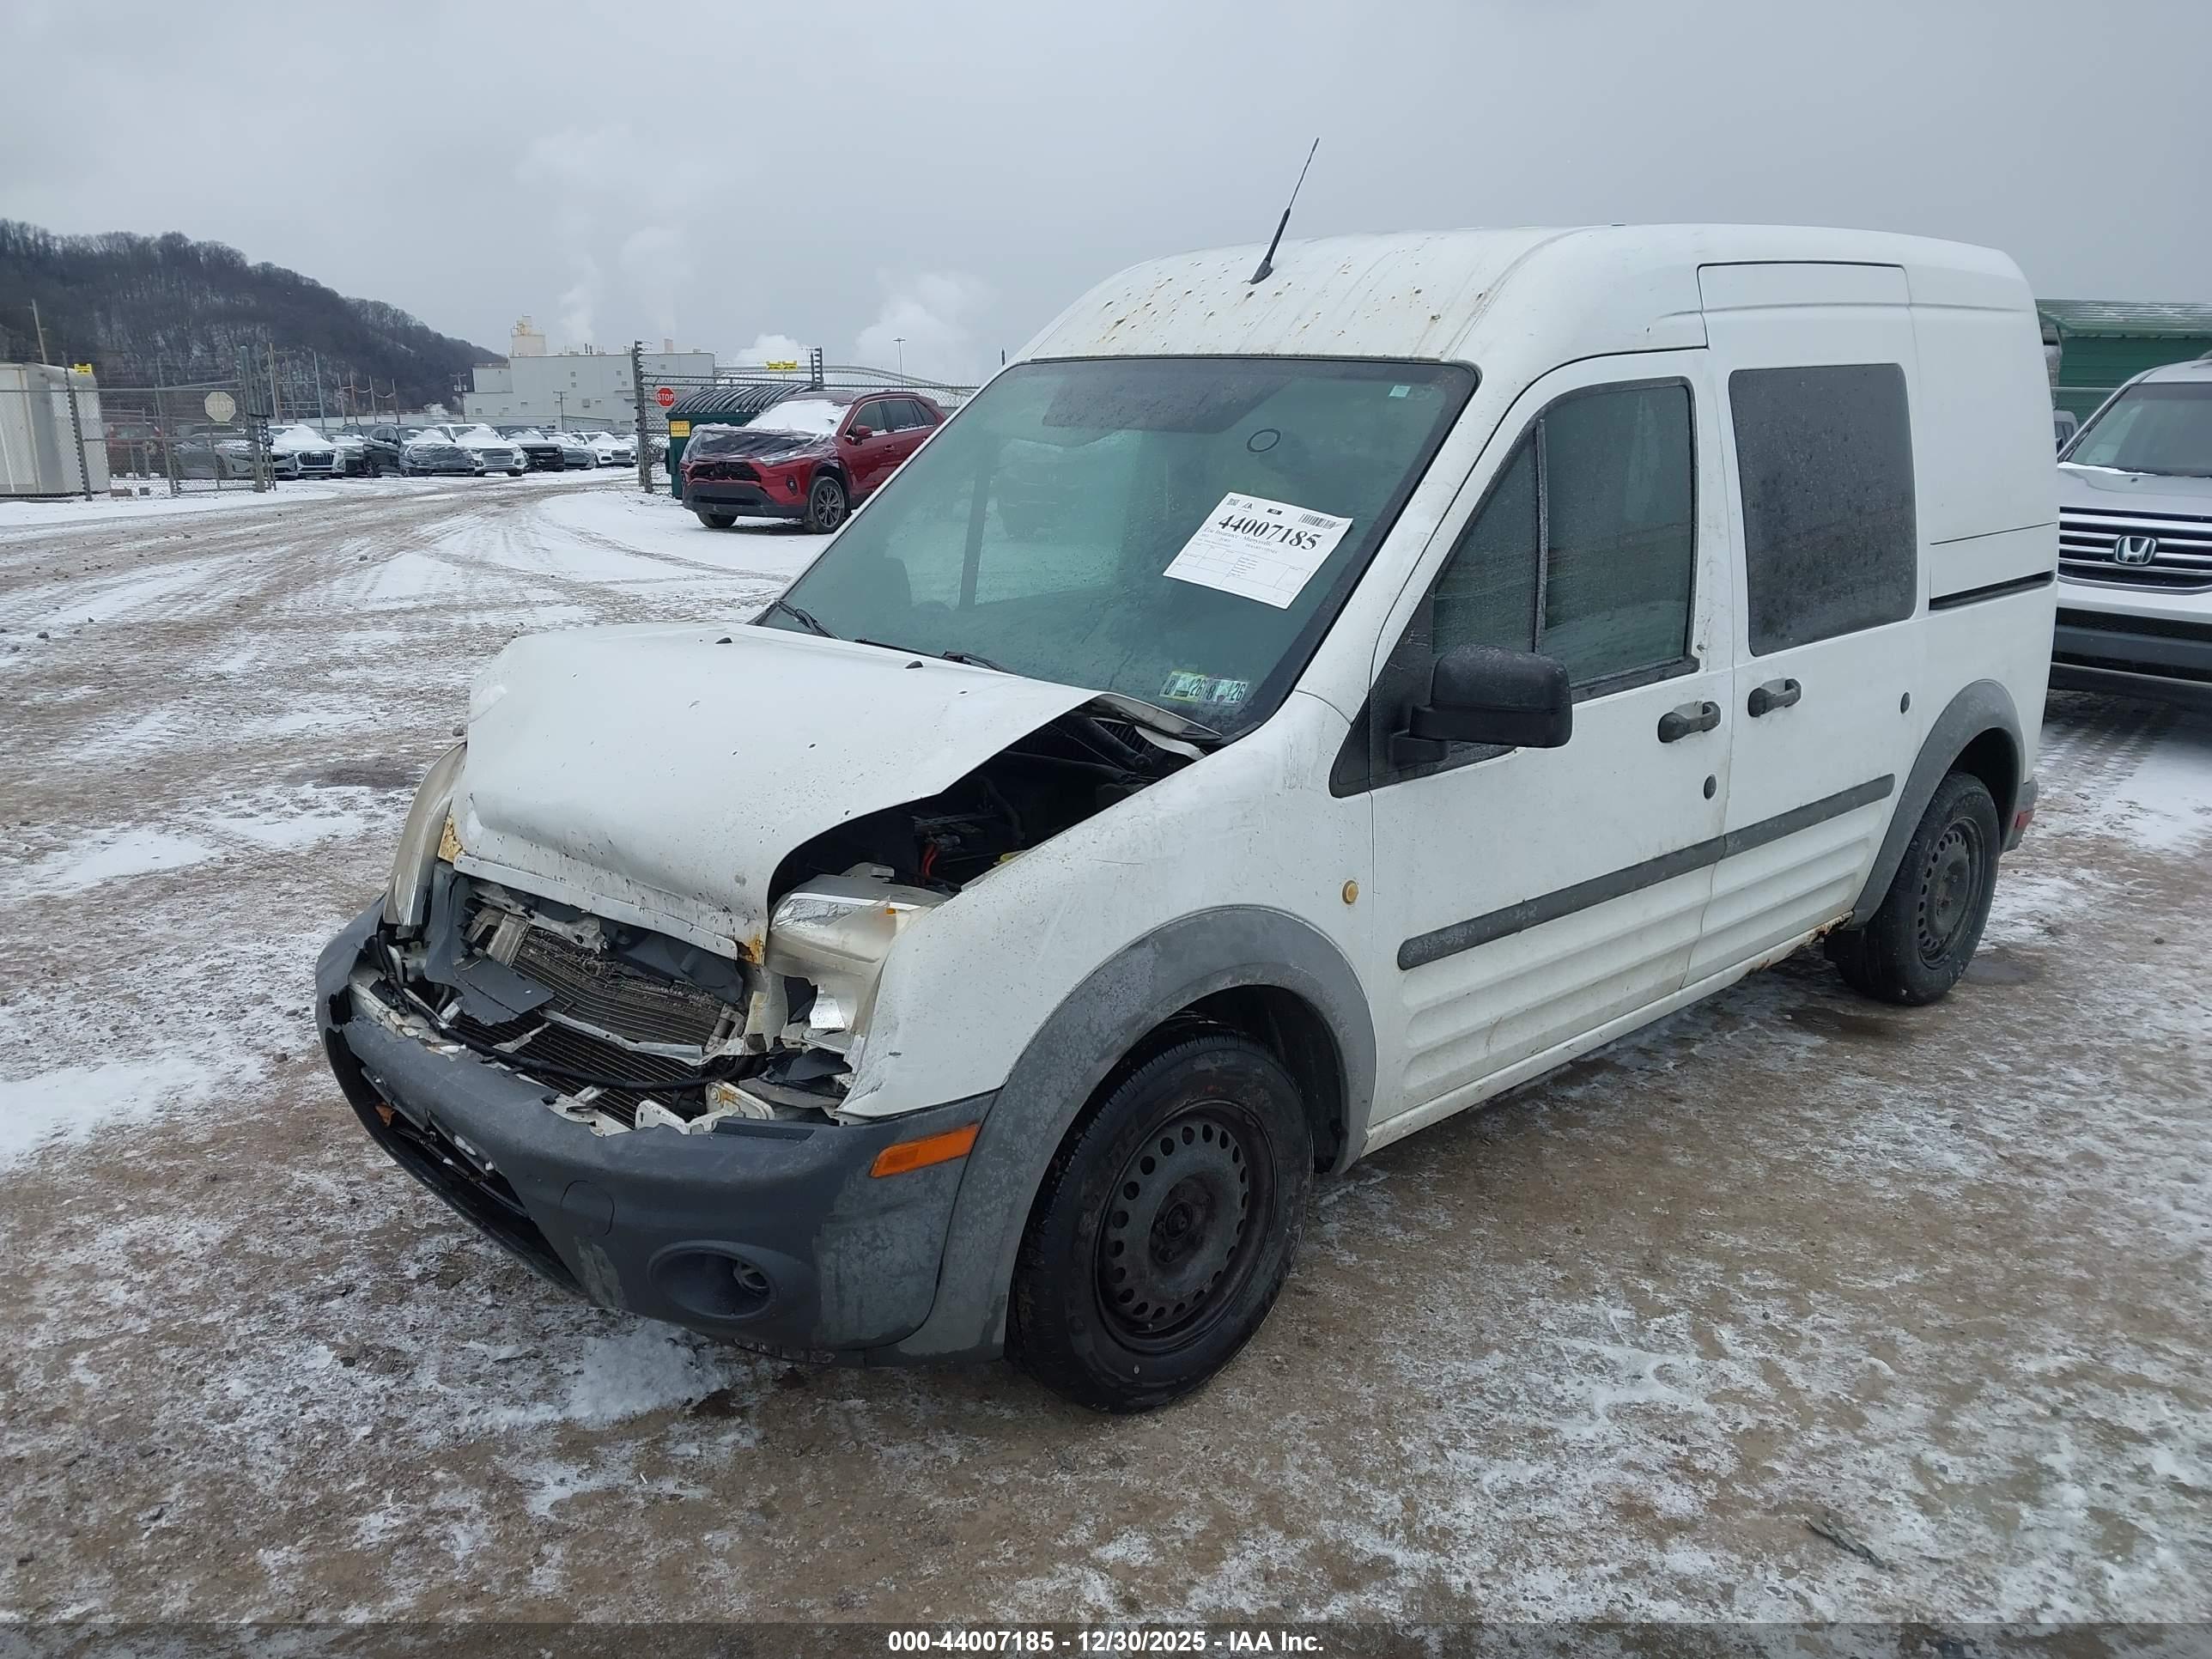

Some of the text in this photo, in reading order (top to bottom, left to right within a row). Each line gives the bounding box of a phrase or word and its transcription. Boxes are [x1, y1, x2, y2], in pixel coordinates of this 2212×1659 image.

[207, 400, 233, 412] STOP
[657, 392, 674, 402] STOP
[1218, 514, 1322, 550] 44007185
[1189, 678, 1206, 696] 26
[1206, 683, 1246, 702] 8 26
